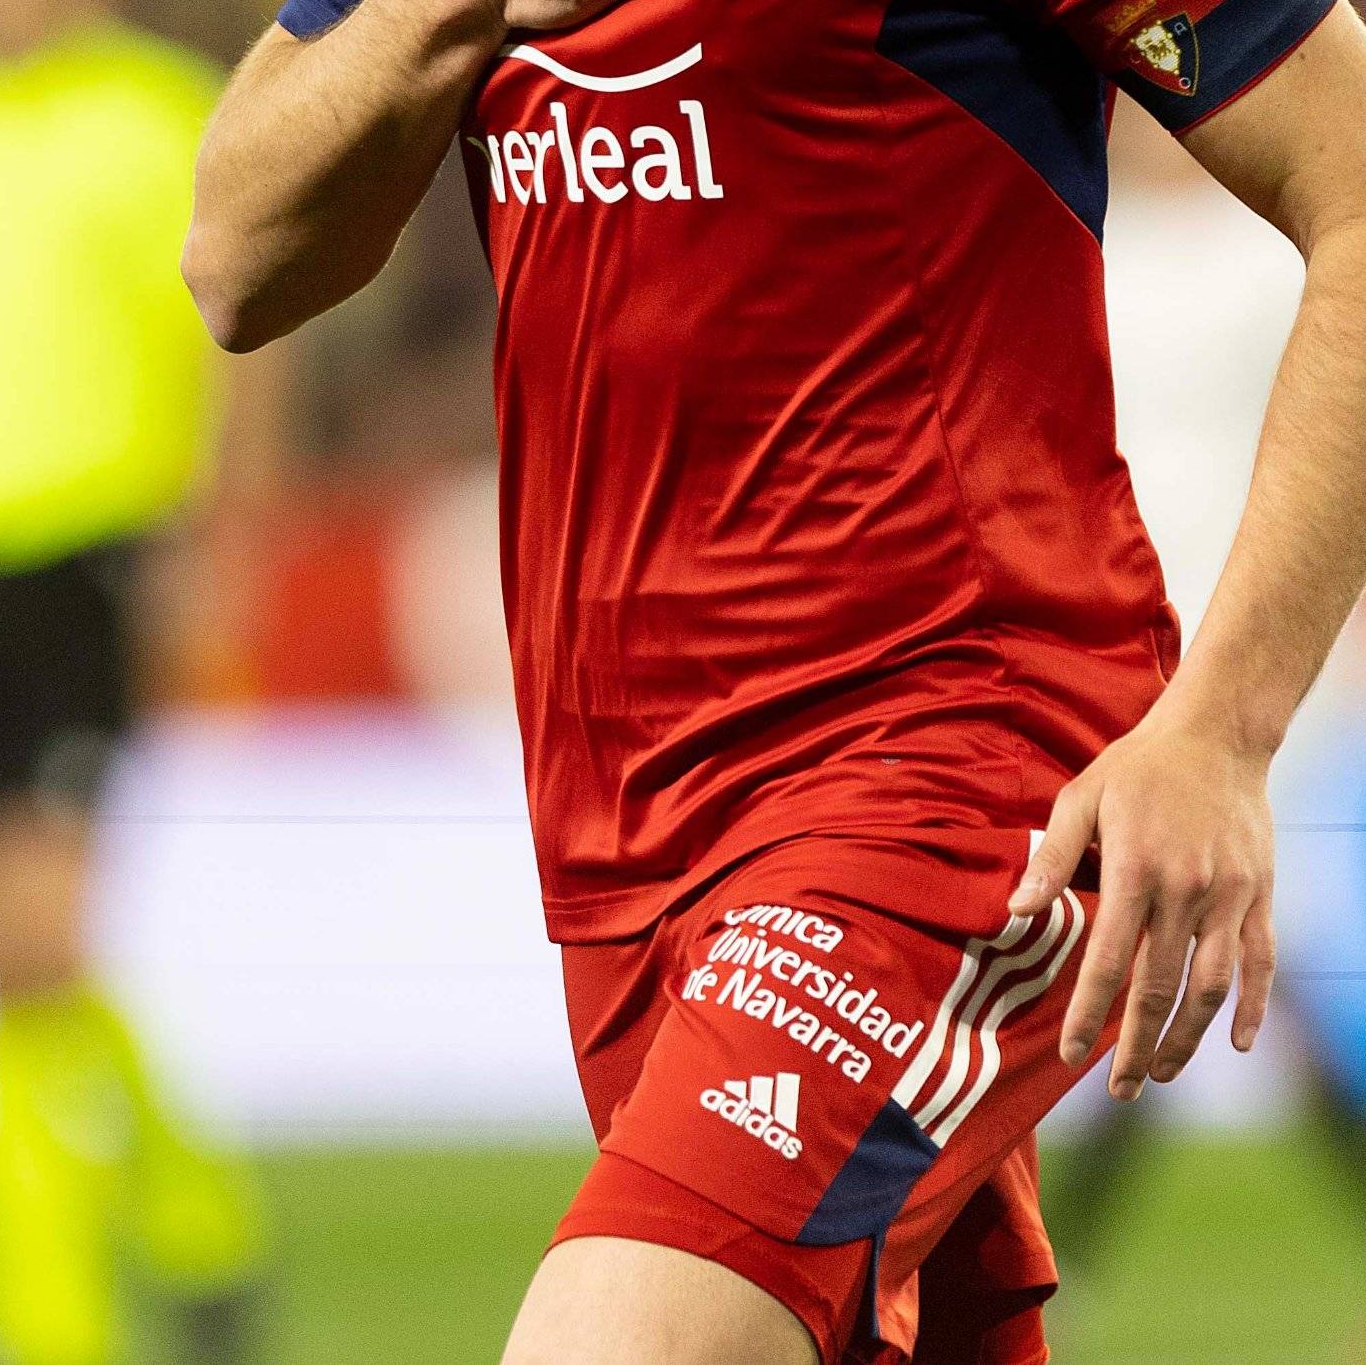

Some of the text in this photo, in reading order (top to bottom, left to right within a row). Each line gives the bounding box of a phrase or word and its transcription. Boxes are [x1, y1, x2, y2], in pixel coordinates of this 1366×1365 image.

[681, 963, 872, 1084] de Navarra
[707, 926, 925, 1059] Universidad
[700, 1087, 803, 1160] adidas
